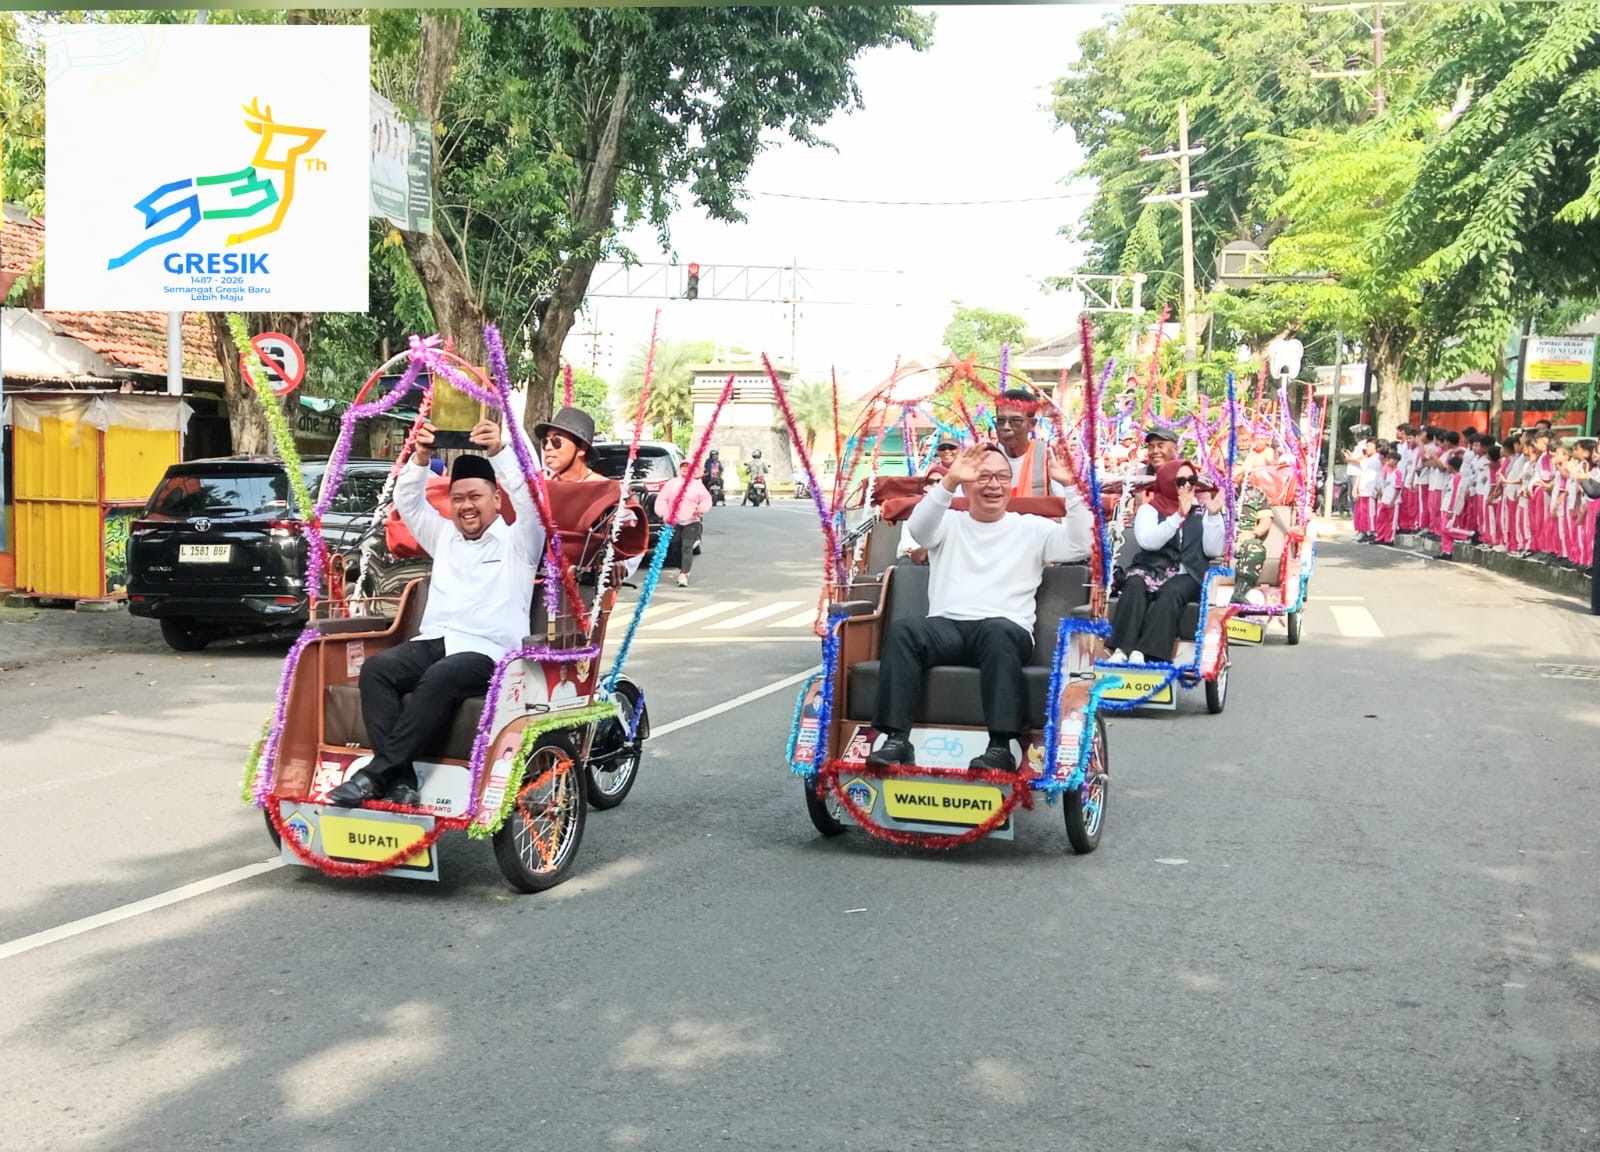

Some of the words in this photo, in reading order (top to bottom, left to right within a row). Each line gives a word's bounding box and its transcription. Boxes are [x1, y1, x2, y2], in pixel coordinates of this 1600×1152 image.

[894, 793, 939, 808] WAKIL
[942, 797, 992, 811] BUPATI
[348, 832, 399, 849] BUPATI
